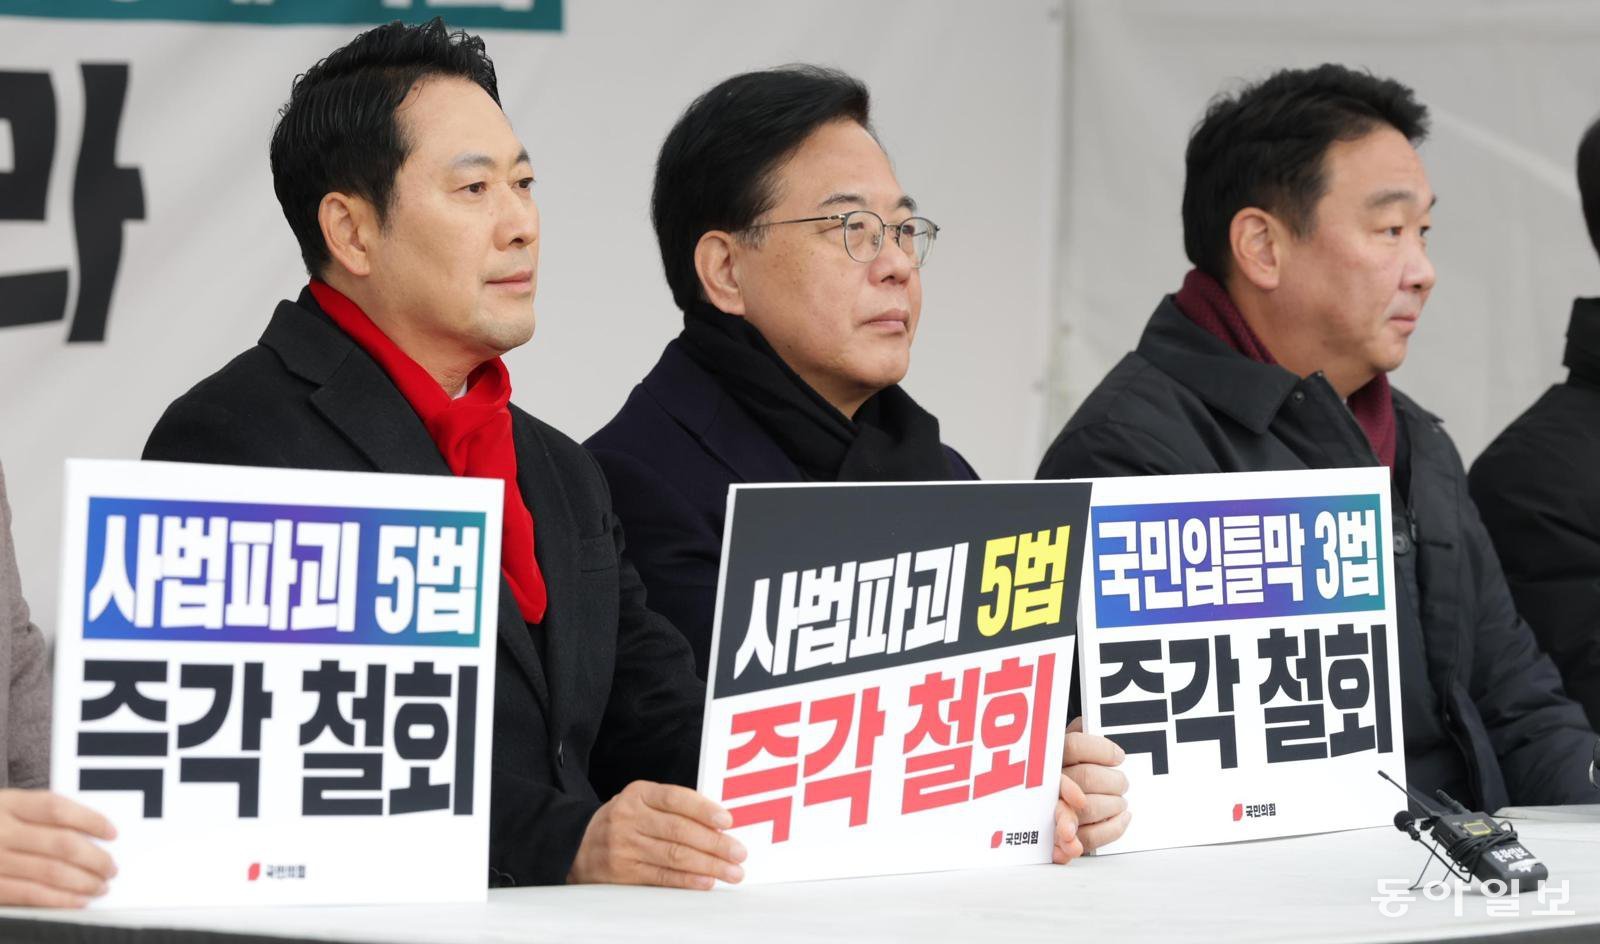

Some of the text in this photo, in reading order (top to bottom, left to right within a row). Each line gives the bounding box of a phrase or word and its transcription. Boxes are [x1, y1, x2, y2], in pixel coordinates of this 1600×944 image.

[88, 514, 480, 634] 사법파괴 5법
[733, 525, 1071, 680] 사법파괴 5법
[1099, 509, 1379, 612] 국민입틀막 3법
[76, 659, 480, 818] 즉각 철회
[721, 652, 1056, 844] 즉각 철회
[1098, 623, 1394, 776] 즉각 철회
[1005, 831, 1039, 845] 국민의힘
[1245, 803, 1276, 818] 국민의힘
